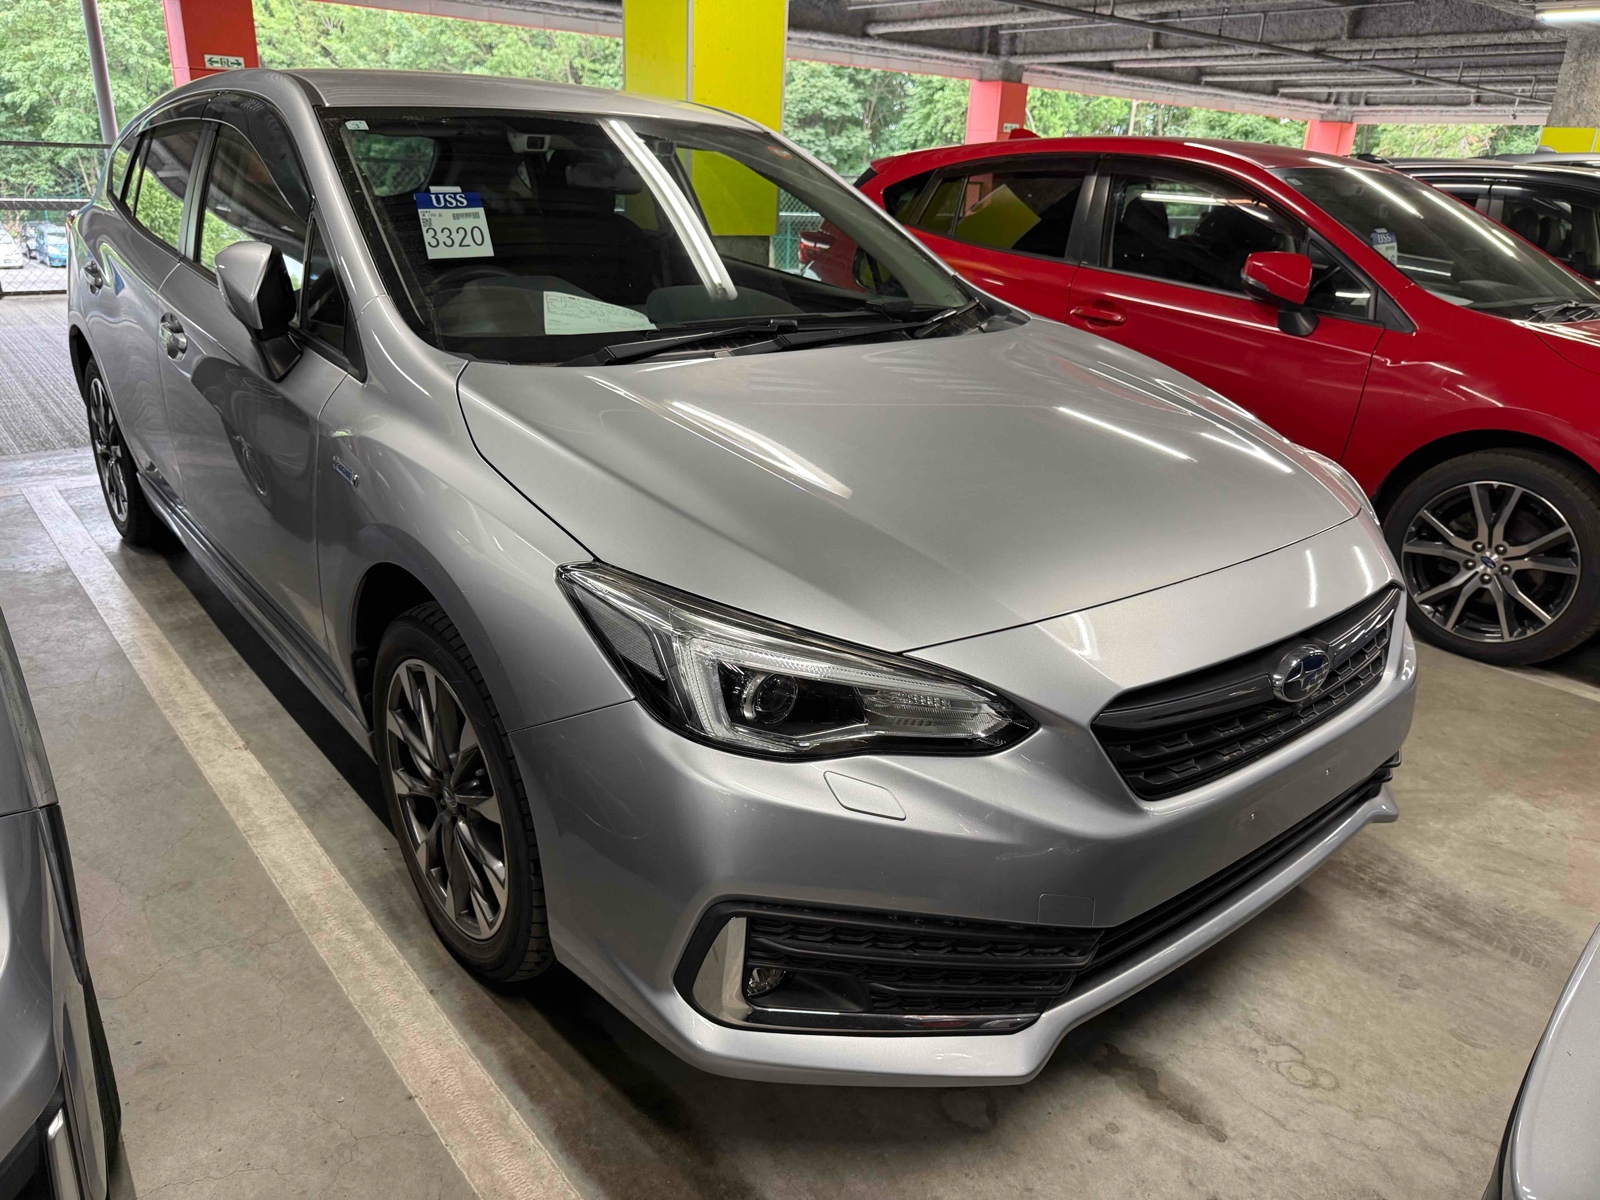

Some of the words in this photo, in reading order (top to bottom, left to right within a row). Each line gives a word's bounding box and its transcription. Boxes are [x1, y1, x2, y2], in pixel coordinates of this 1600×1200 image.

[430, 193, 468, 208] USS
[425, 225, 485, 248] 3320
[1377, 233, 1392, 243] USS
